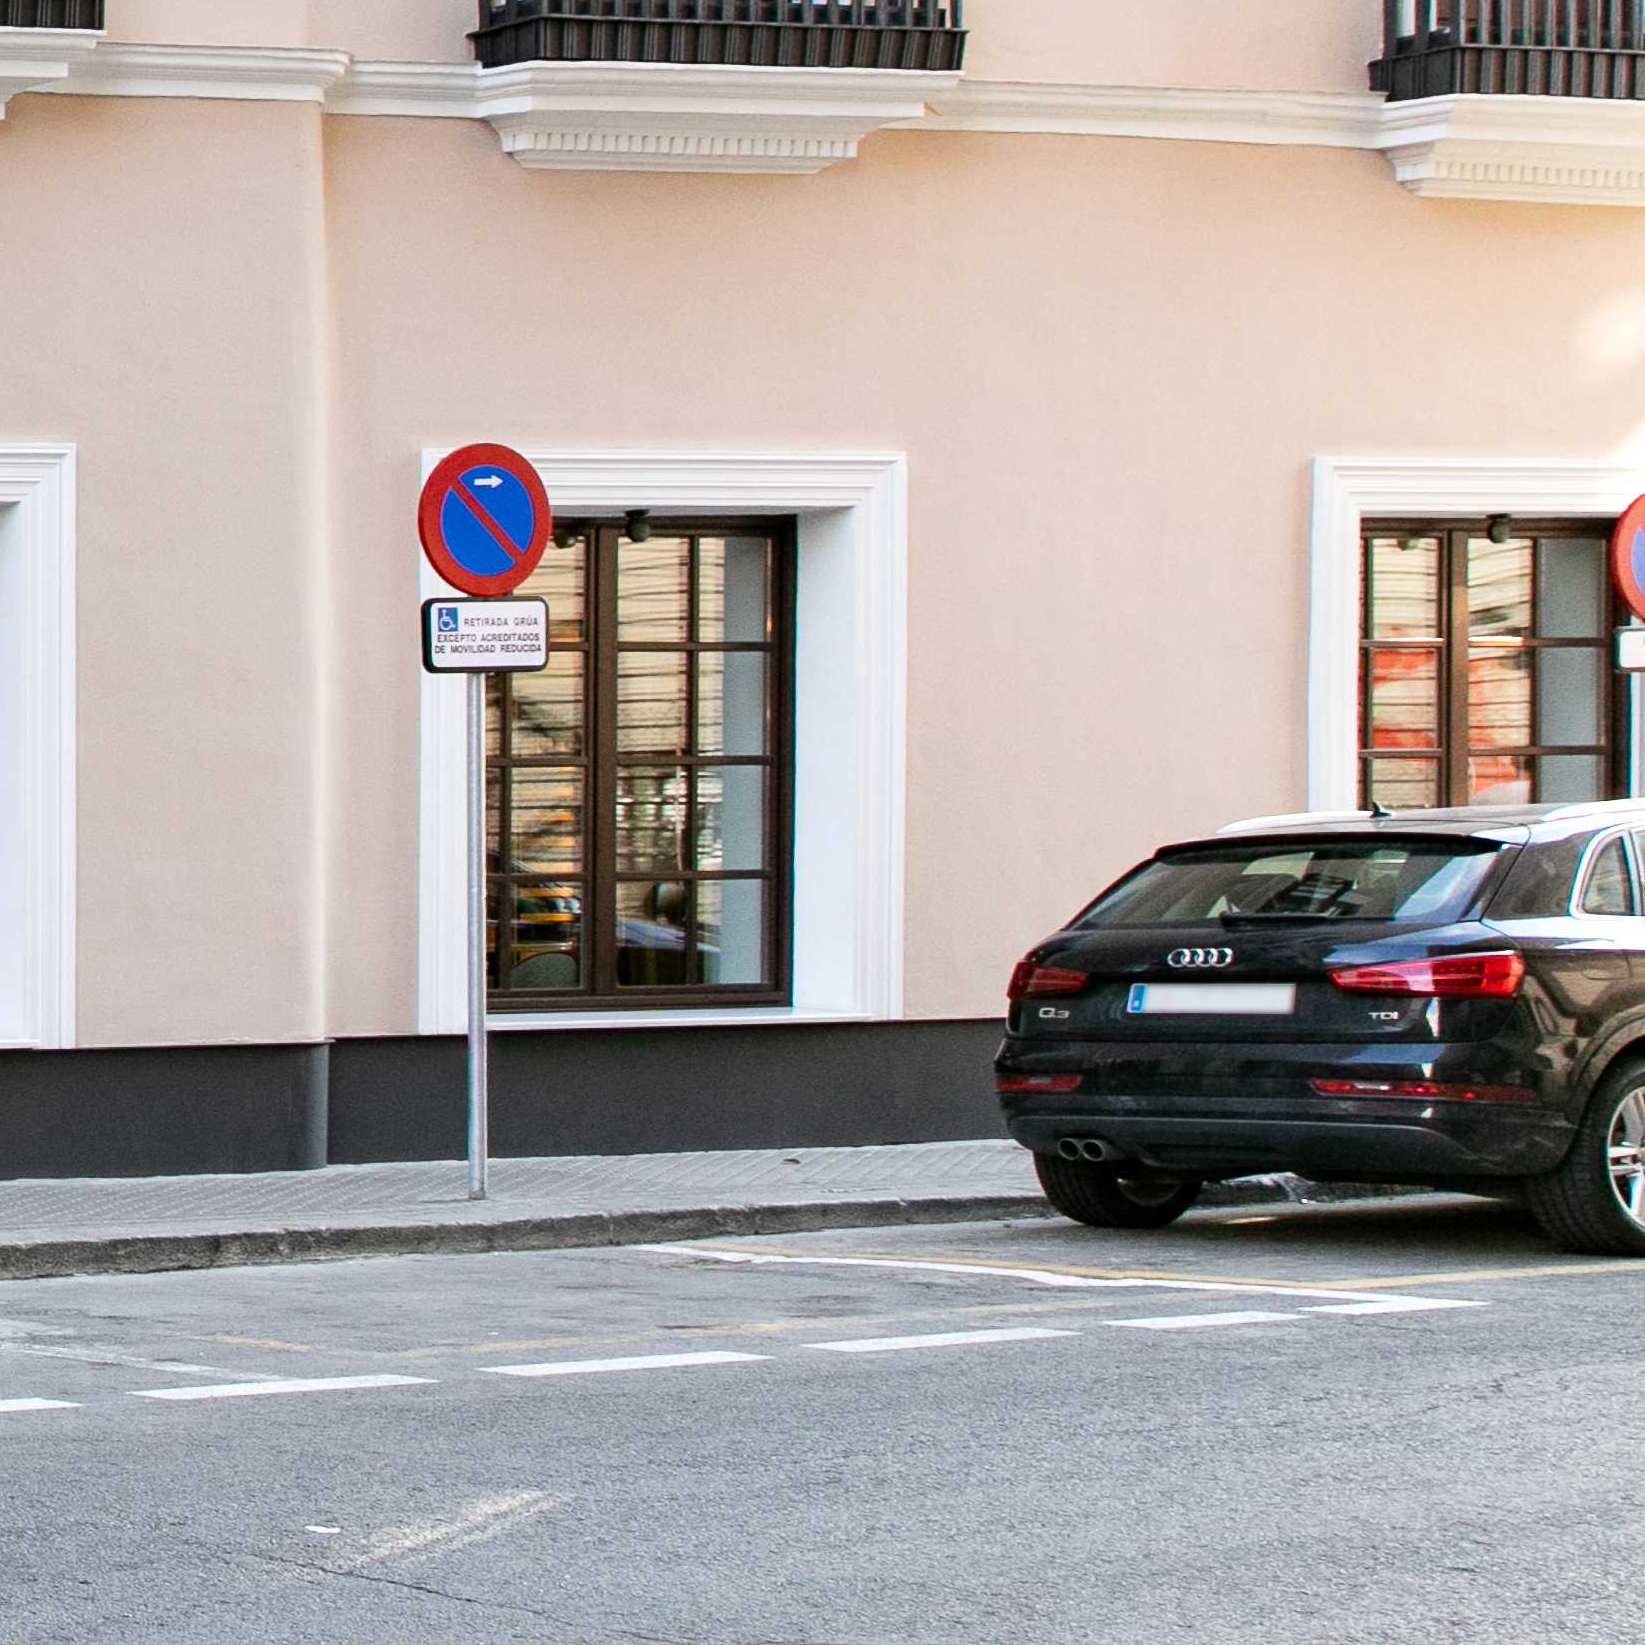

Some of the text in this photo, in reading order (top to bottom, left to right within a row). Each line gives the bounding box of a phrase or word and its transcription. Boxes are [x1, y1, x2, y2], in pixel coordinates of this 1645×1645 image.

[464, 615, 538, 626] RETIRADA GRÚA
[437, 633, 540, 642] EXCEPTO ACREDITADOS
[435, 644, 542, 654] DE MOVILIDAD REDUCIDA
[1039, 1007, 1070, 1018] Q3
[1368, 1011, 1399, 1020] TDI
